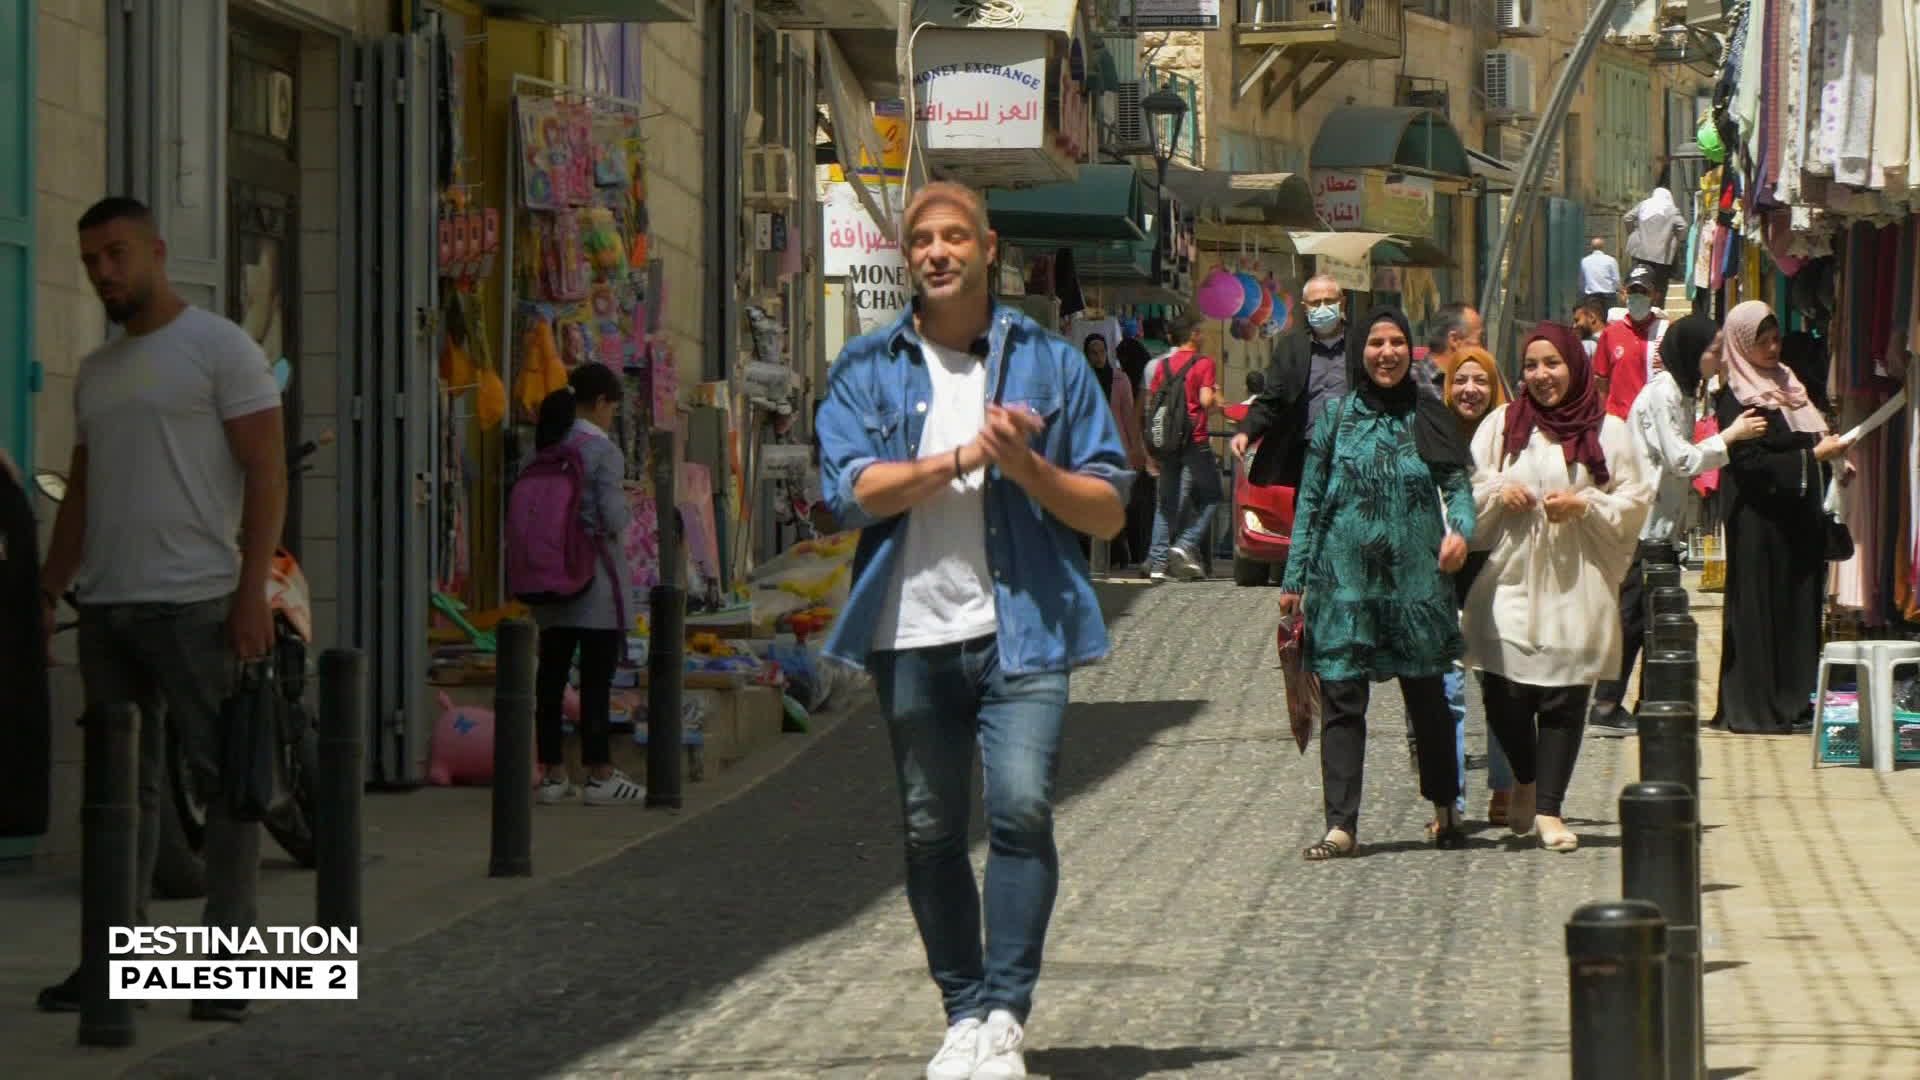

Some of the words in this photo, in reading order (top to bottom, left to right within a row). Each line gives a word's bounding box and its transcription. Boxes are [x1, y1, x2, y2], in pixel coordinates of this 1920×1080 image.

[964, 62, 1041, 90] EXCHANGE
[999, 100, 1037, 125] العز
[848, 264, 905, 286] MONE
